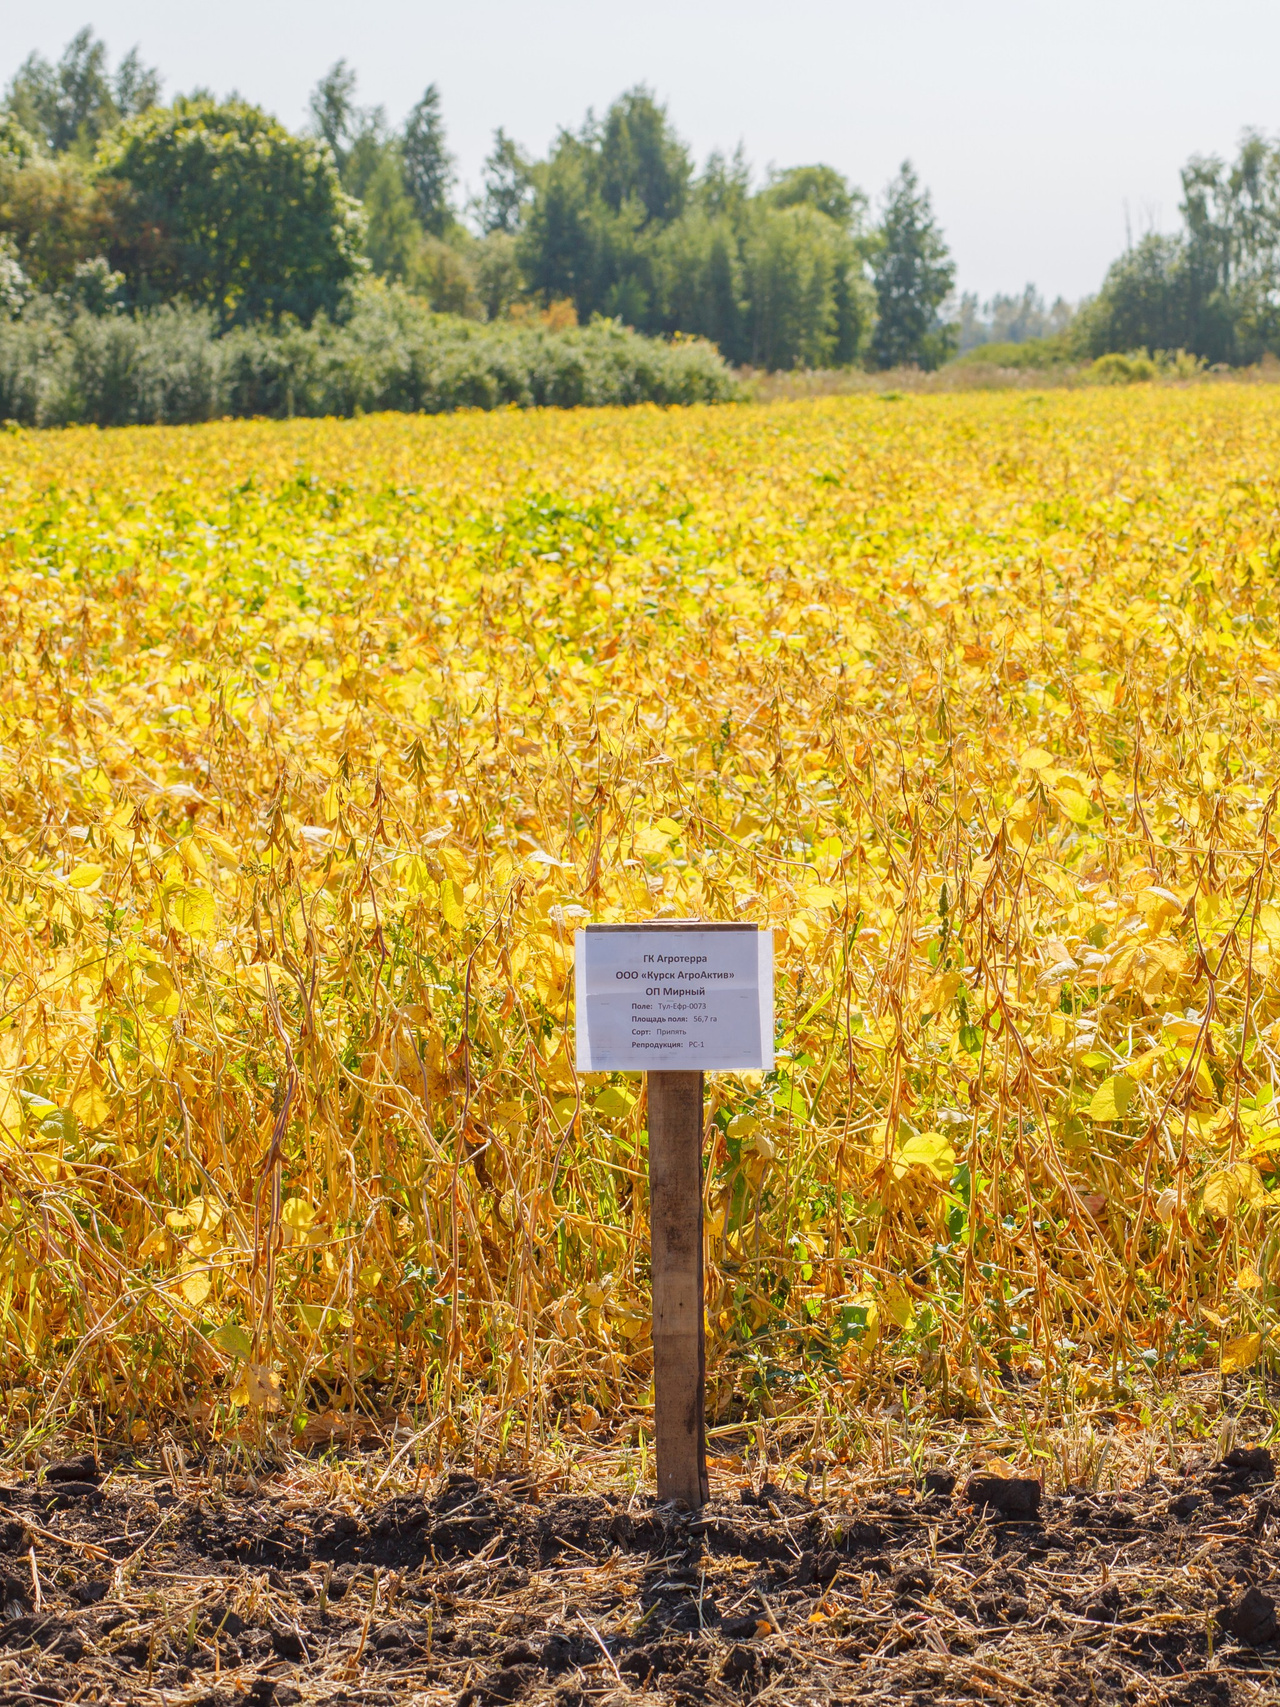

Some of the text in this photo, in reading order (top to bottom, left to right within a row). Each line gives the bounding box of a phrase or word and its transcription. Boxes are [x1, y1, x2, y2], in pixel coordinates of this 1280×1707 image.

[643, 954, 708, 964] ГК Агротерра
[616, 971, 735, 981] ООО «Курск АгроАктив»
[645, 987, 705, 996] ОП Мирный
[658, 1003, 706, 1011] Тул-Ефр-0073
[631, 1016, 666, 1024] Площадь
[693, 1015, 708, 1023] 56,7
[631, 1028, 687, 1037] Сорт: Припять
[631, 1041, 683, 1049] Репродукция:
